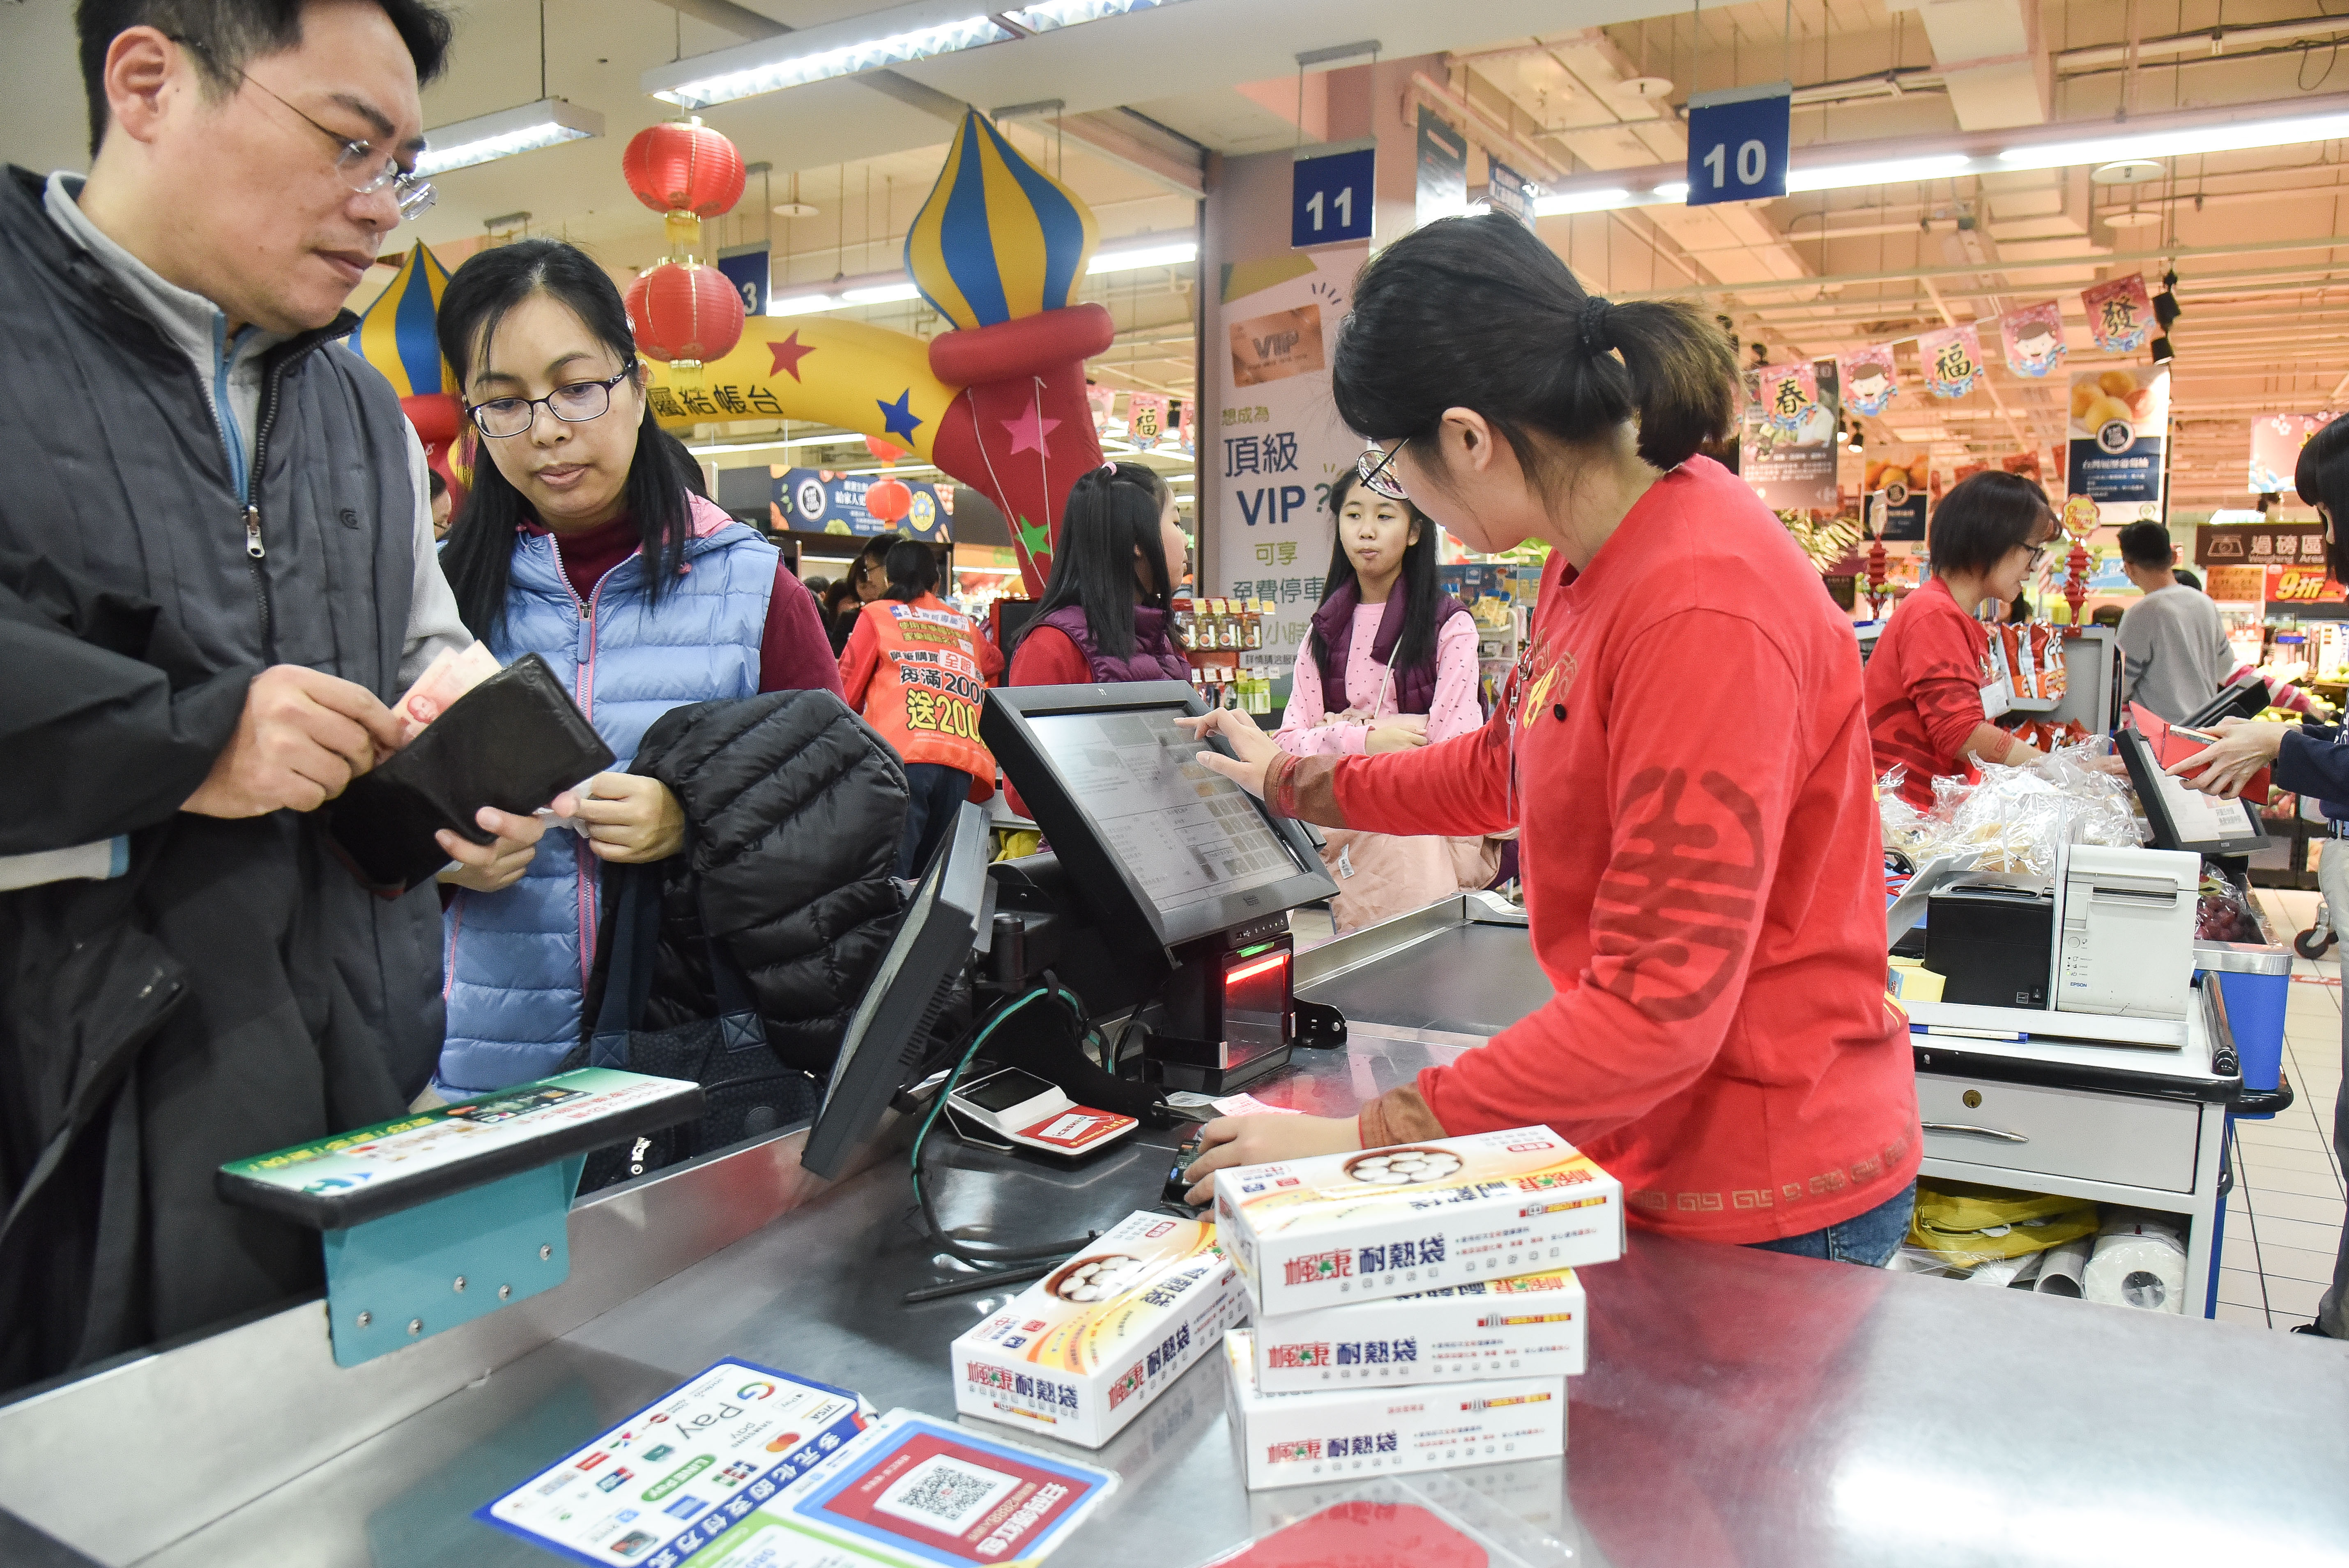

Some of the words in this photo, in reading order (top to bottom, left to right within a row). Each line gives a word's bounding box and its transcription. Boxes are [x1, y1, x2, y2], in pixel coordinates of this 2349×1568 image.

[1703, 138, 1766, 189] 10
[1307, 187, 1352, 230] 11
[2102, 296, 2138, 336] 發
[1936, 342, 1971, 380] 福
[1776, 378, 1806, 414] 春
[1136, 408, 1157, 436] 福
[1224, 432, 1298, 477] 頂級
[1236, 485, 1306, 526] VIP
[1254, 541, 1298, 566] 可享
[1232, 576, 1326, 604] 免費停車
[906, 688, 980, 744] 送200
[674, 1401, 743, 1440] Pay
[729, 1421, 757, 1439] pay
[810, 1402, 838, 1420] VISA
[729, 1419, 773, 1448] SAMSUNG
[646, 1477, 680, 1499] Pay
[674, 1458, 709, 1481] LINE
[647, 1431, 842, 1568] 多元化的支付方式
[974, 1482, 1069, 1557] 扫码领红包
